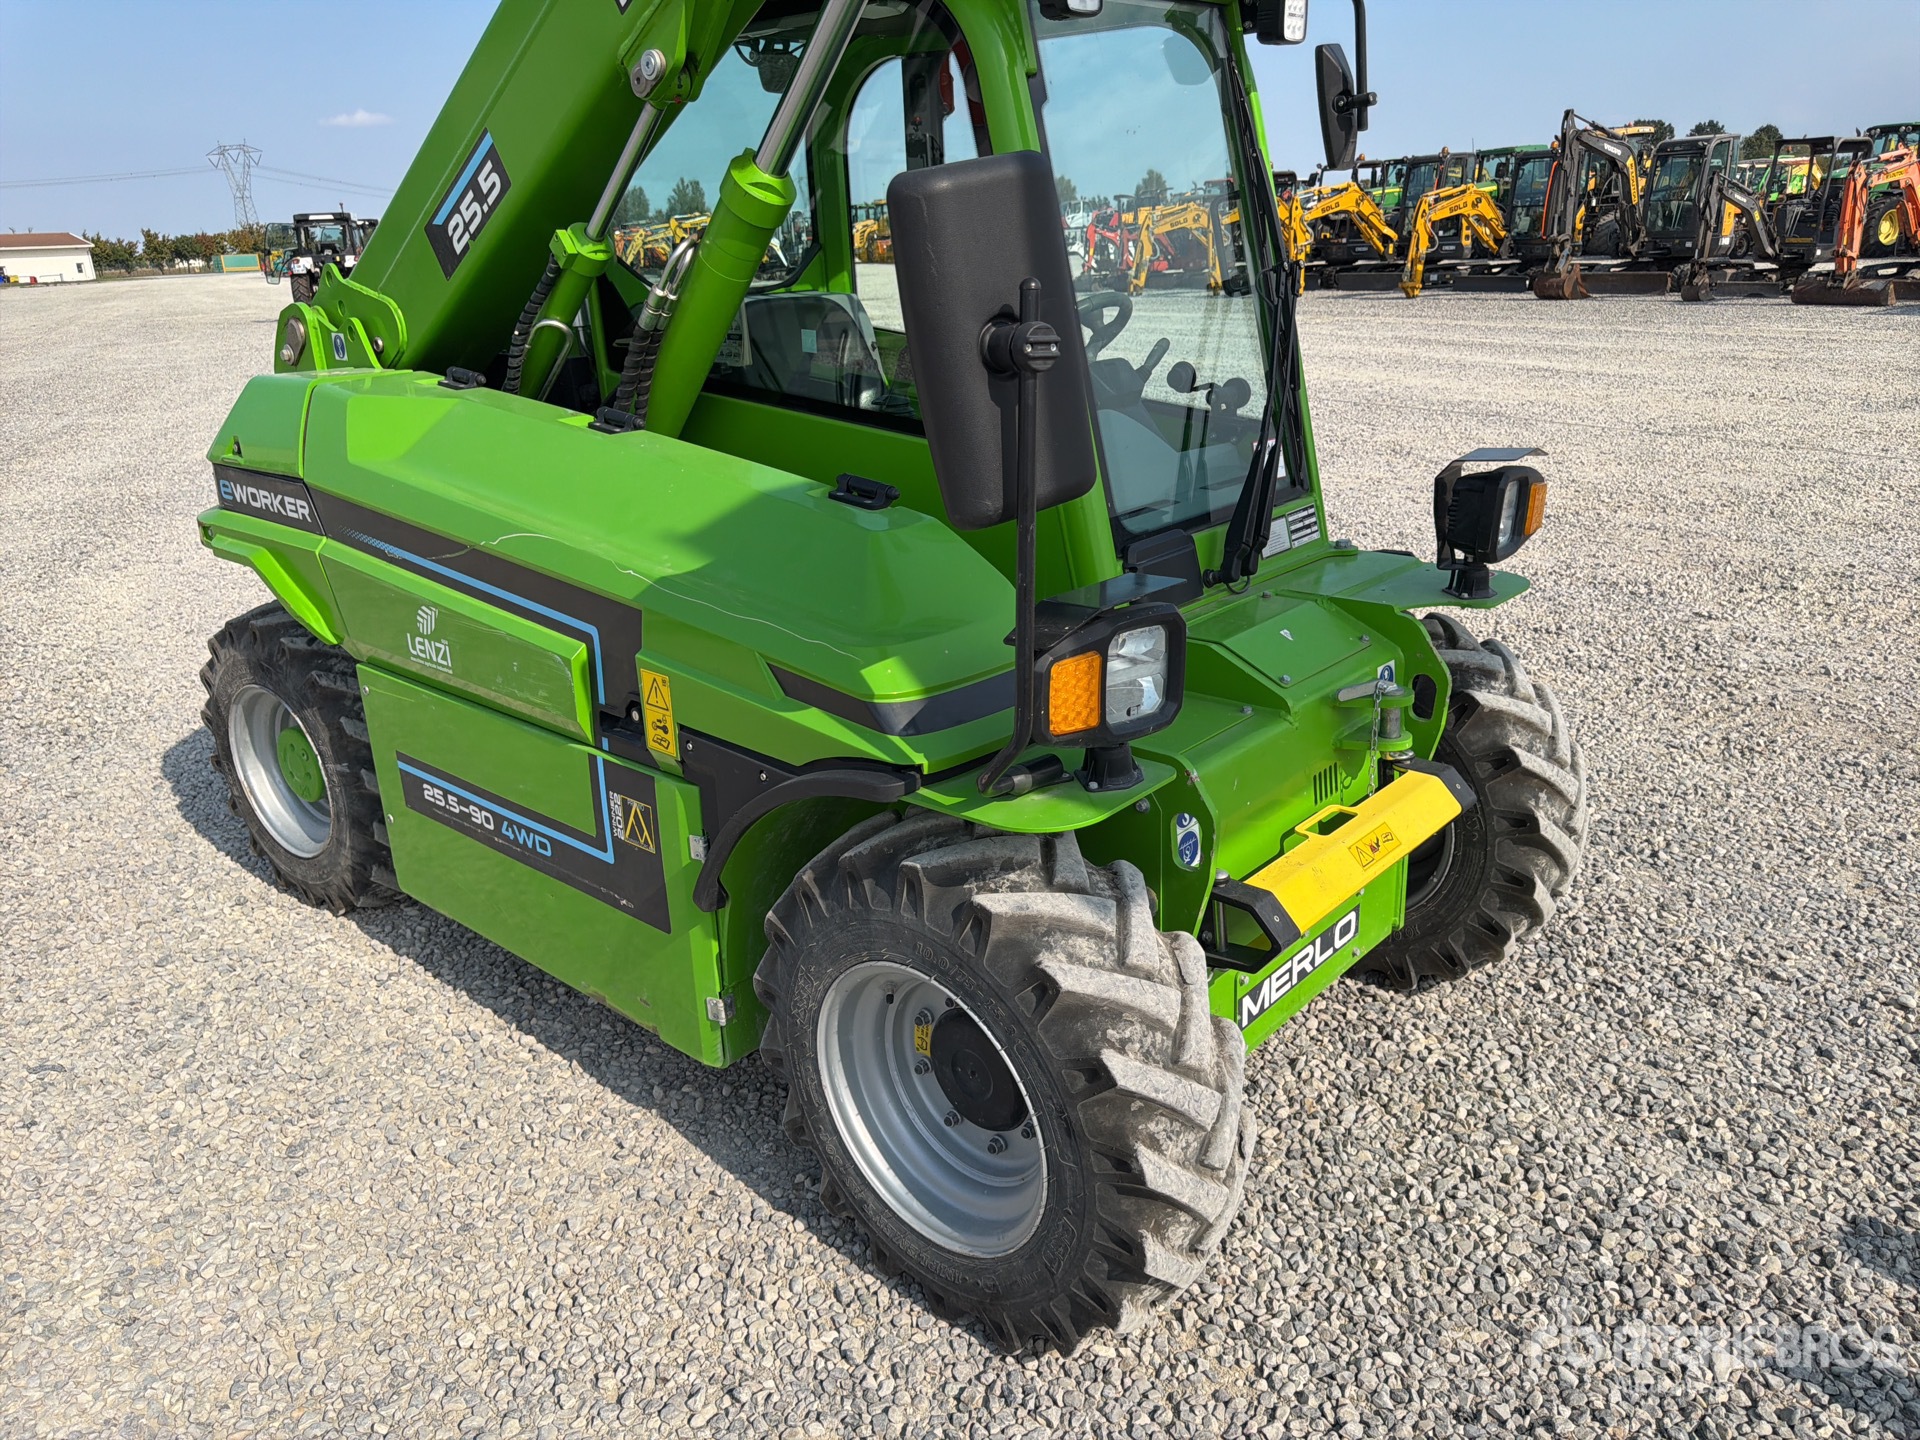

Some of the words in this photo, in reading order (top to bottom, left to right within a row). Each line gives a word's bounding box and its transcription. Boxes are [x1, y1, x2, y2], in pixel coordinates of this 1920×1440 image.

[447, 159, 502, 256] 25.5
[406, 632, 452, 667] LENZI
[422, 783, 495, 831] 25.5-90
[501, 820, 552, 857] 4WD
[608, 790, 618, 838] WINNER
[613, 793, 625, 841] 2022
[1241, 910, 1357, 1029] MERLO
